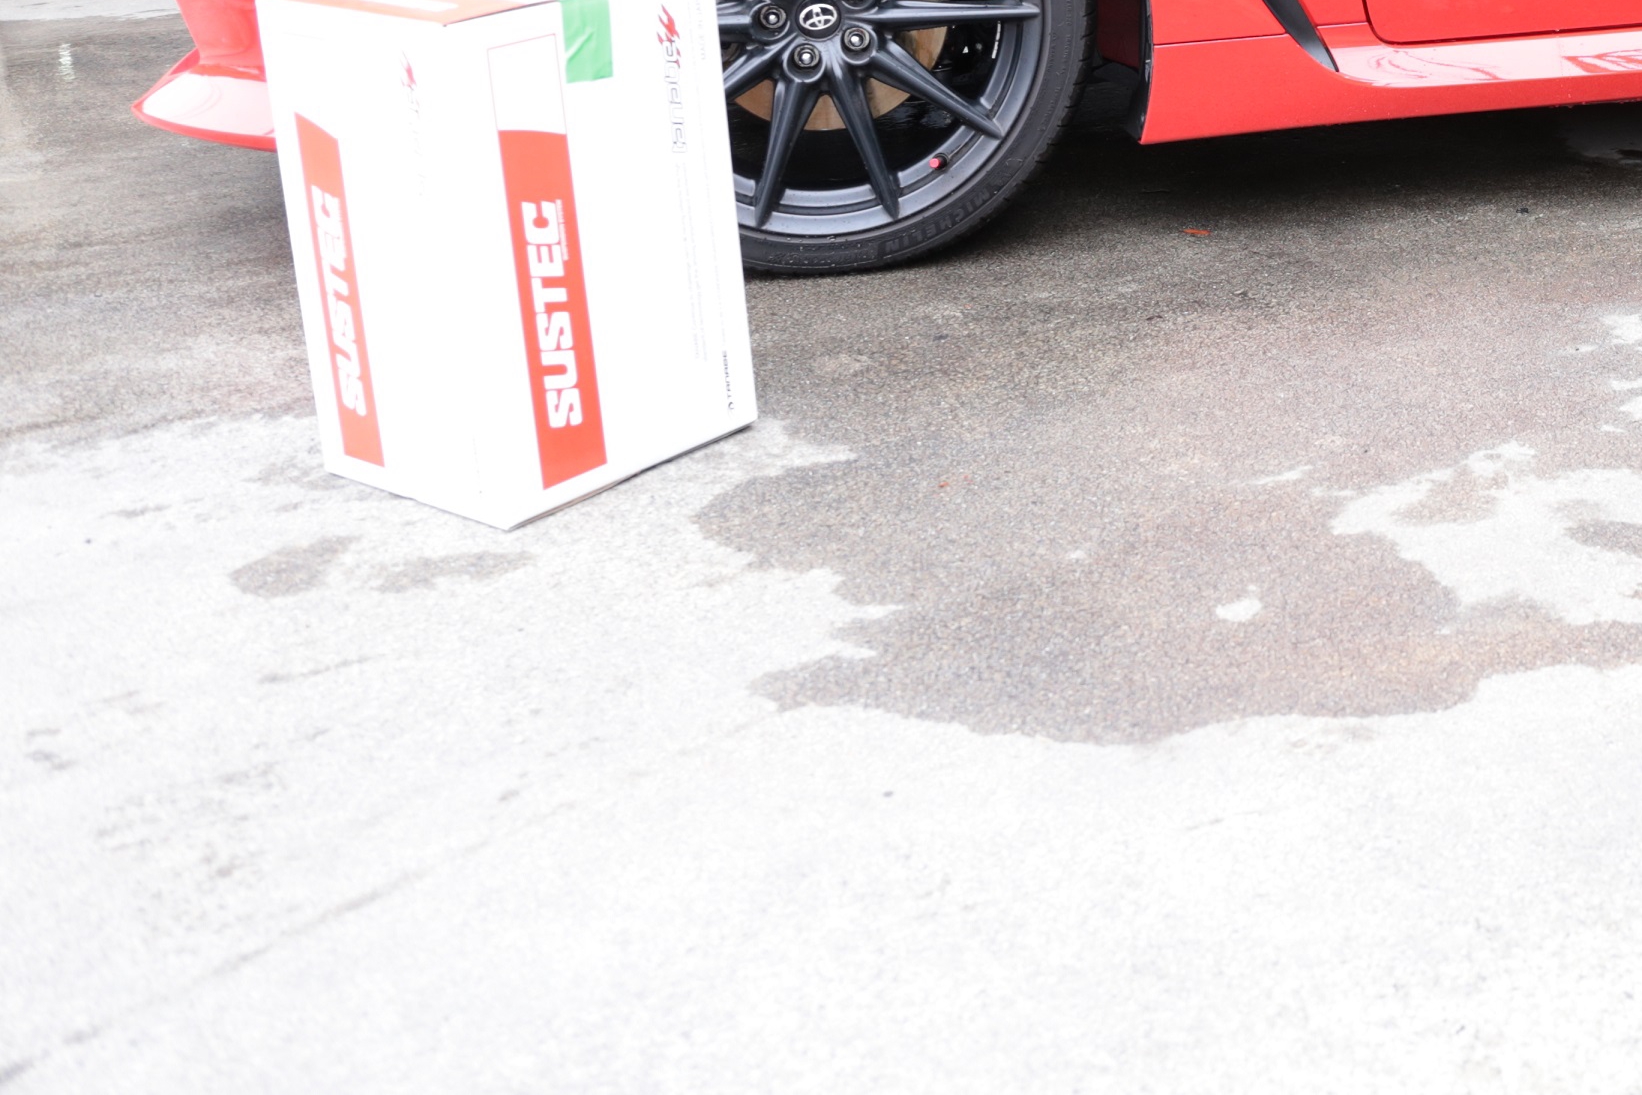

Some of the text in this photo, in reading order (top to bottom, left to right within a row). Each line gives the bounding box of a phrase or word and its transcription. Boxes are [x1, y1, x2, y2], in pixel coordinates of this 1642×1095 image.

[663, 39, 688, 154] tanabe
[884, 188, 991, 253] MICHELIN
[310, 184, 368, 418] SUSTEC
[520, 200, 583, 429] SUSTEC
[721, 350, 733, 400] TANABE
